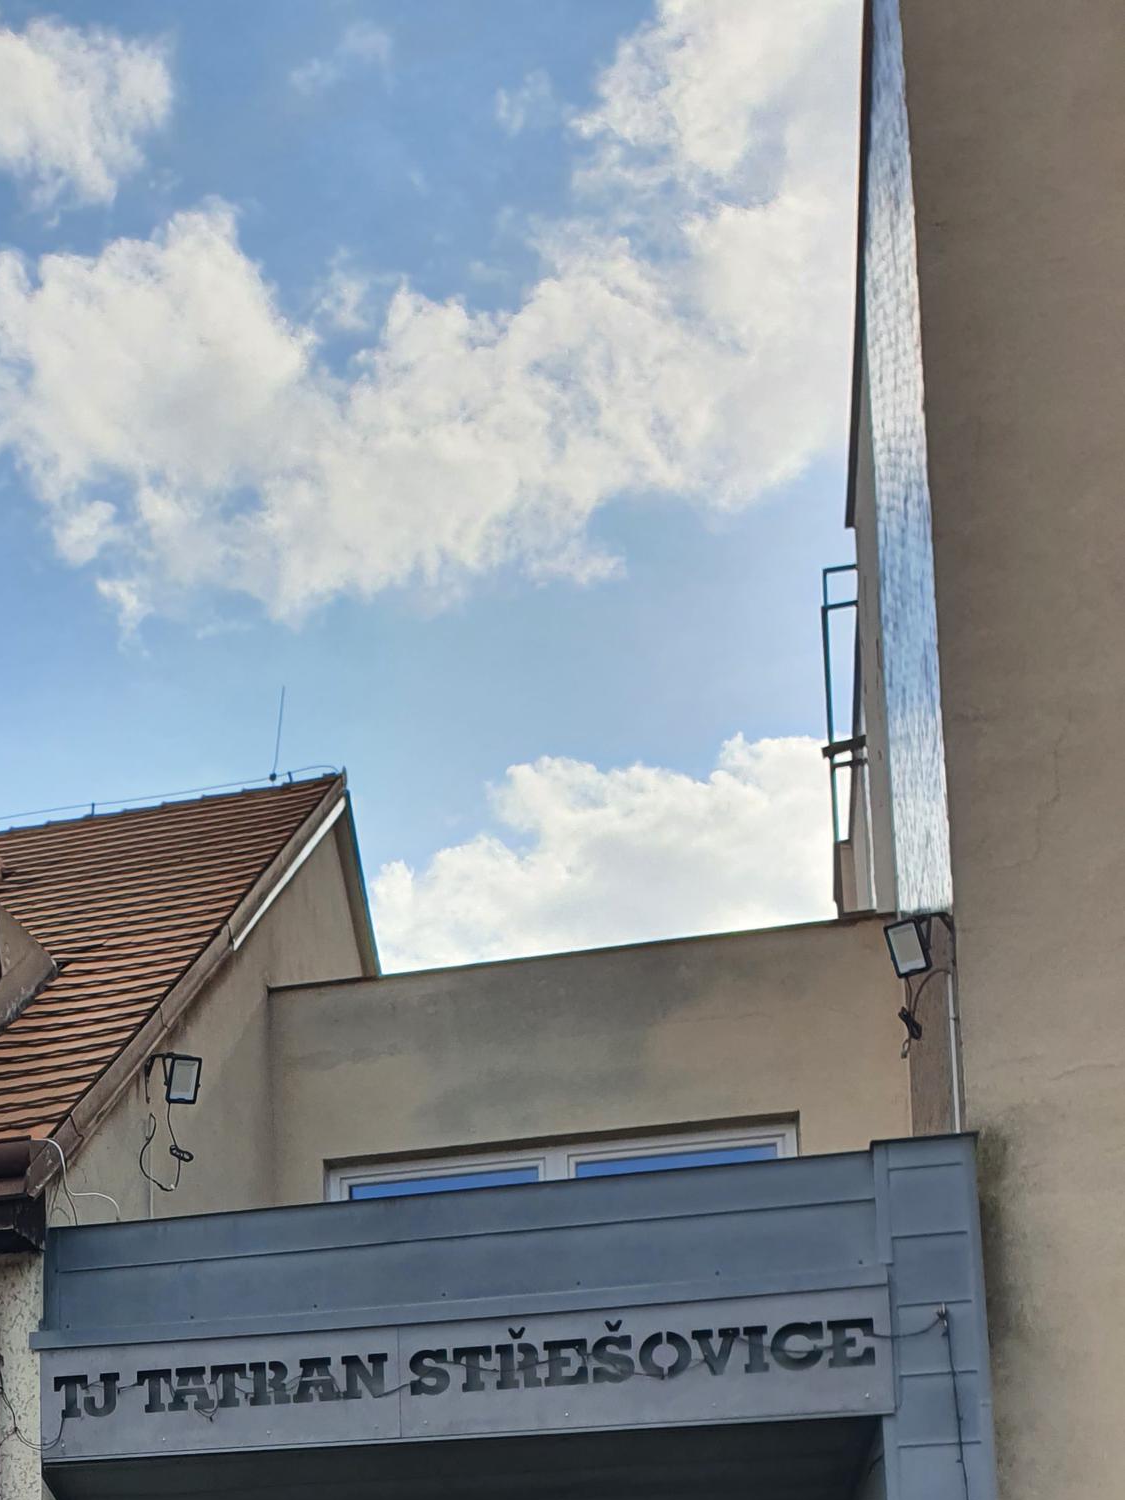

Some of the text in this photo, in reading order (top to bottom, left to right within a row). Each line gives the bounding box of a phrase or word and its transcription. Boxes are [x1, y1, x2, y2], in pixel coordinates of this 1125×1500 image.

[53, 1318, 876, 1419] TJ TATRAN STŘEŠOVICE
